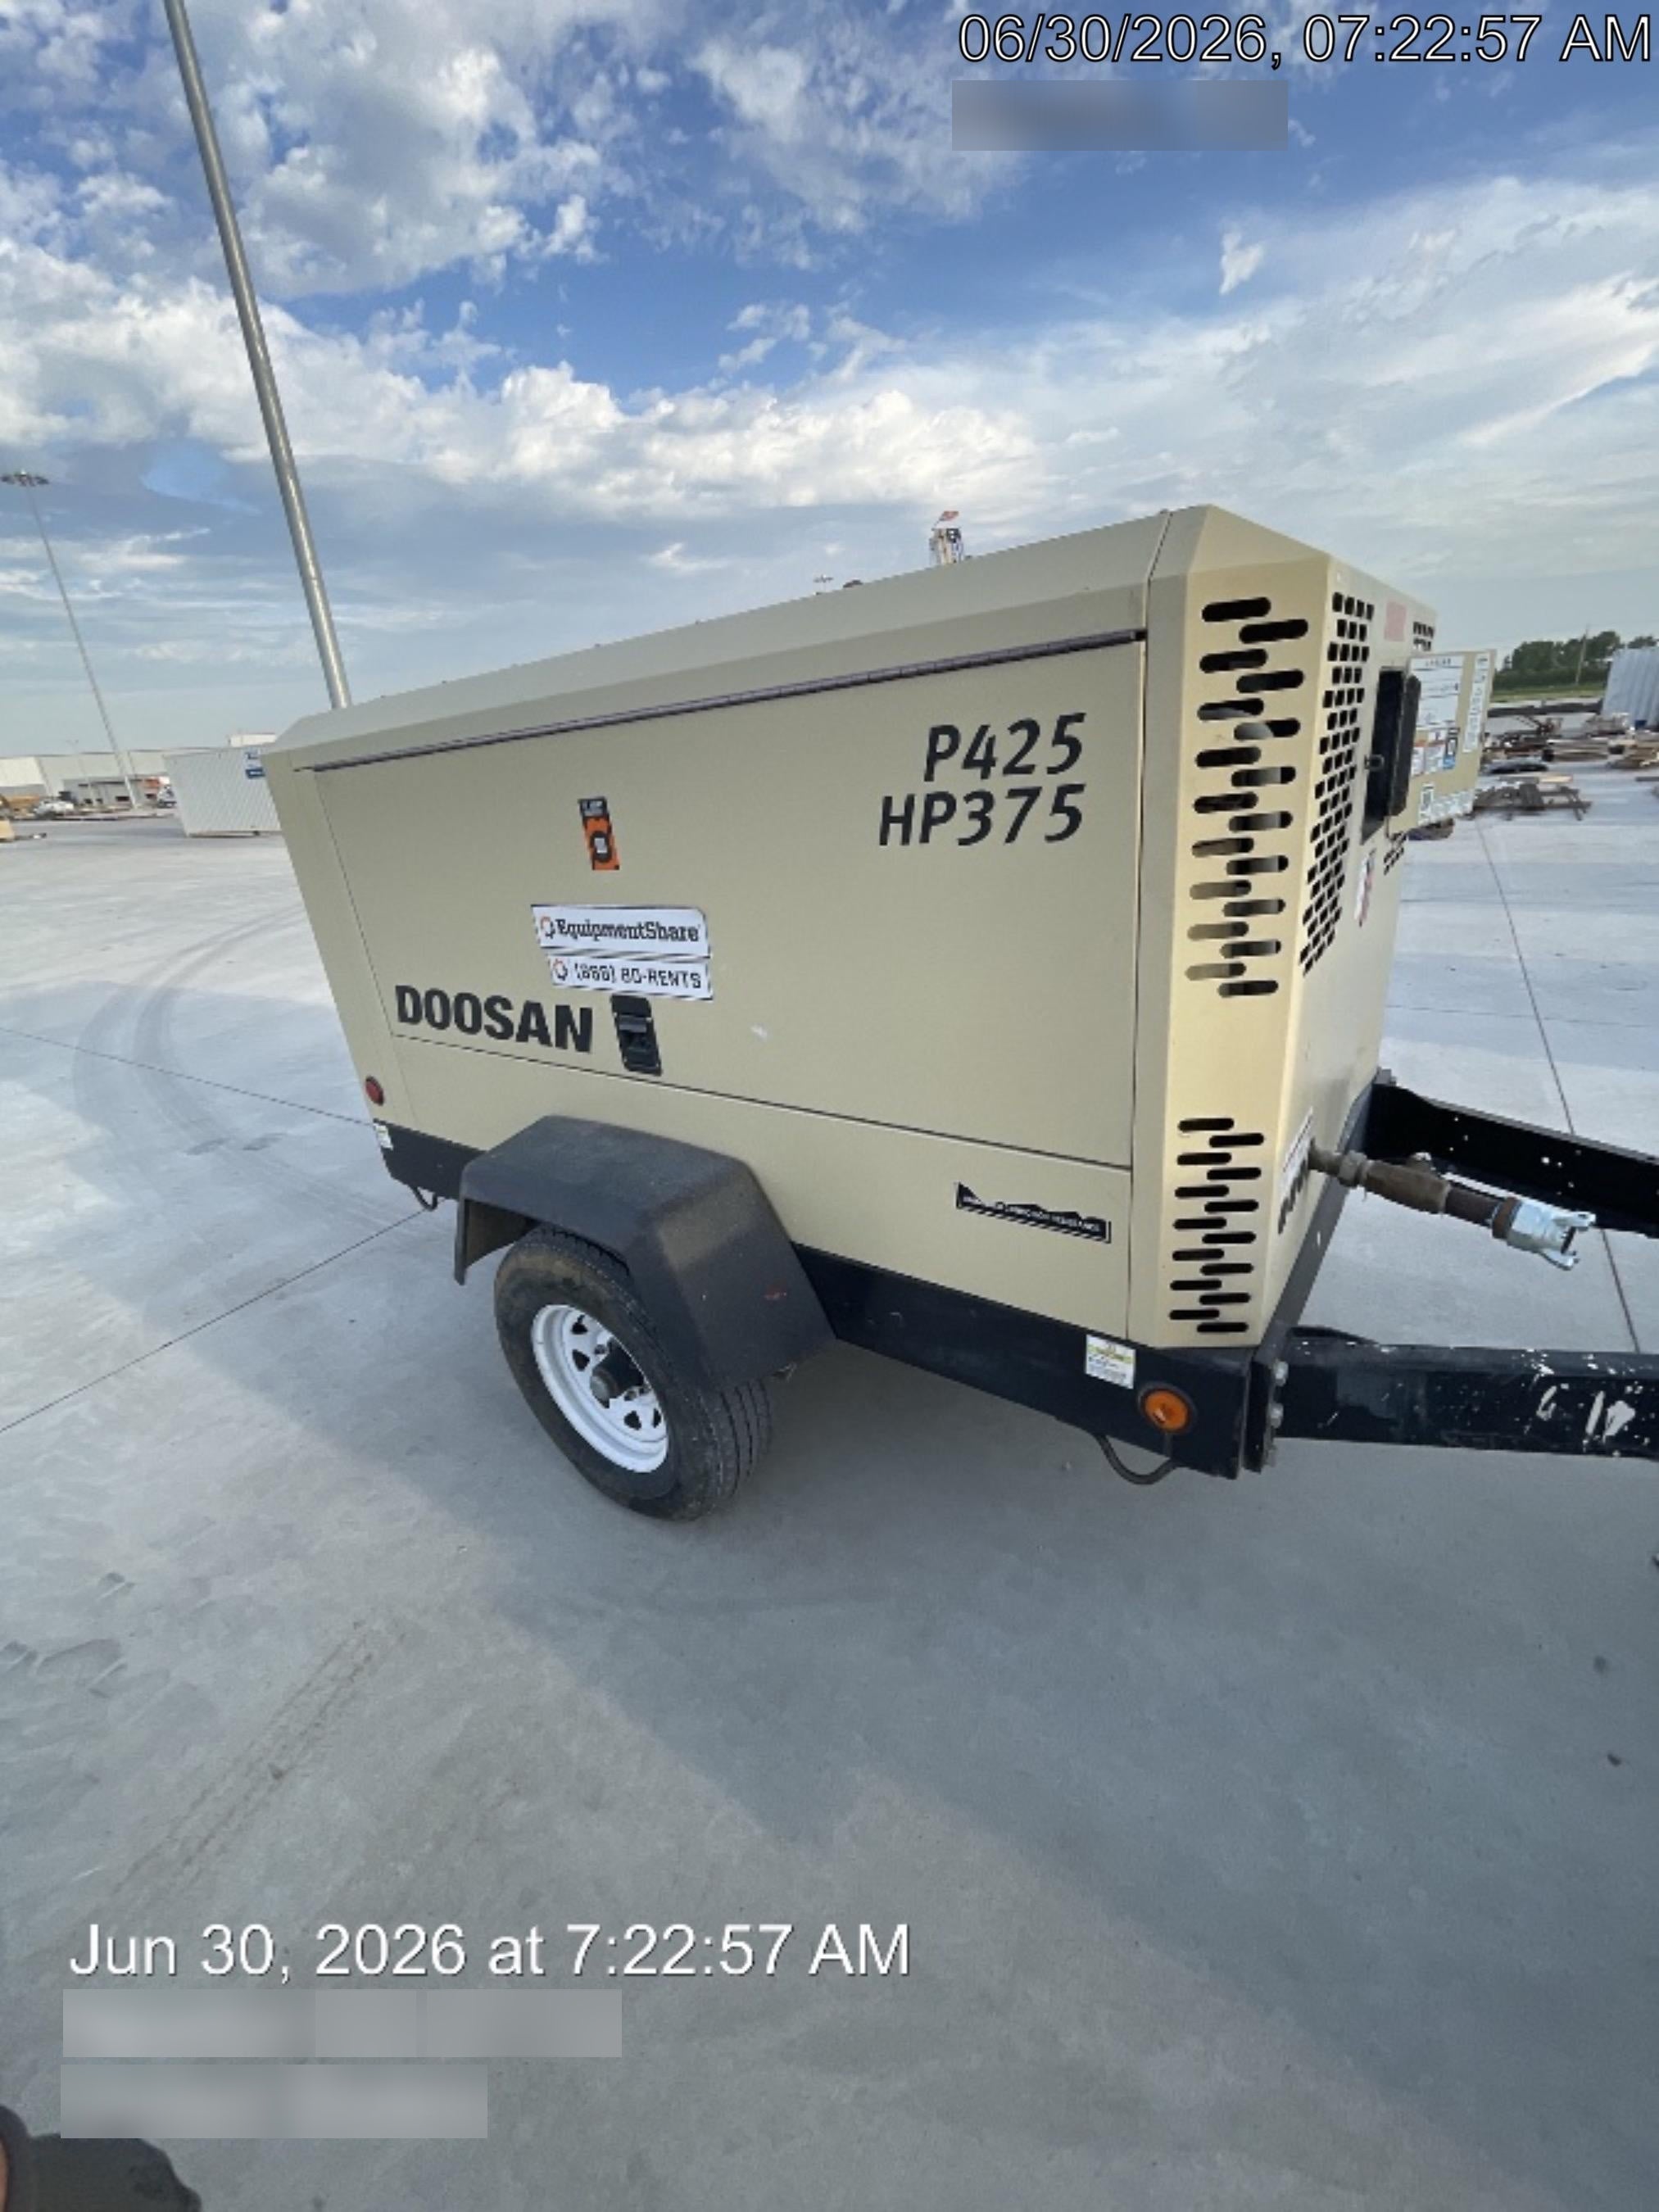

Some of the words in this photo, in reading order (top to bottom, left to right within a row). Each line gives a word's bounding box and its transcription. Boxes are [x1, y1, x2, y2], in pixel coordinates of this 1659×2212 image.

[924, 712, 1086, 782] P425
[879, 783, 1086, 845] HP375
[555, 918, 700, 942] EquipmentShare
[395, 985, 592, 1053] DOOSAN
